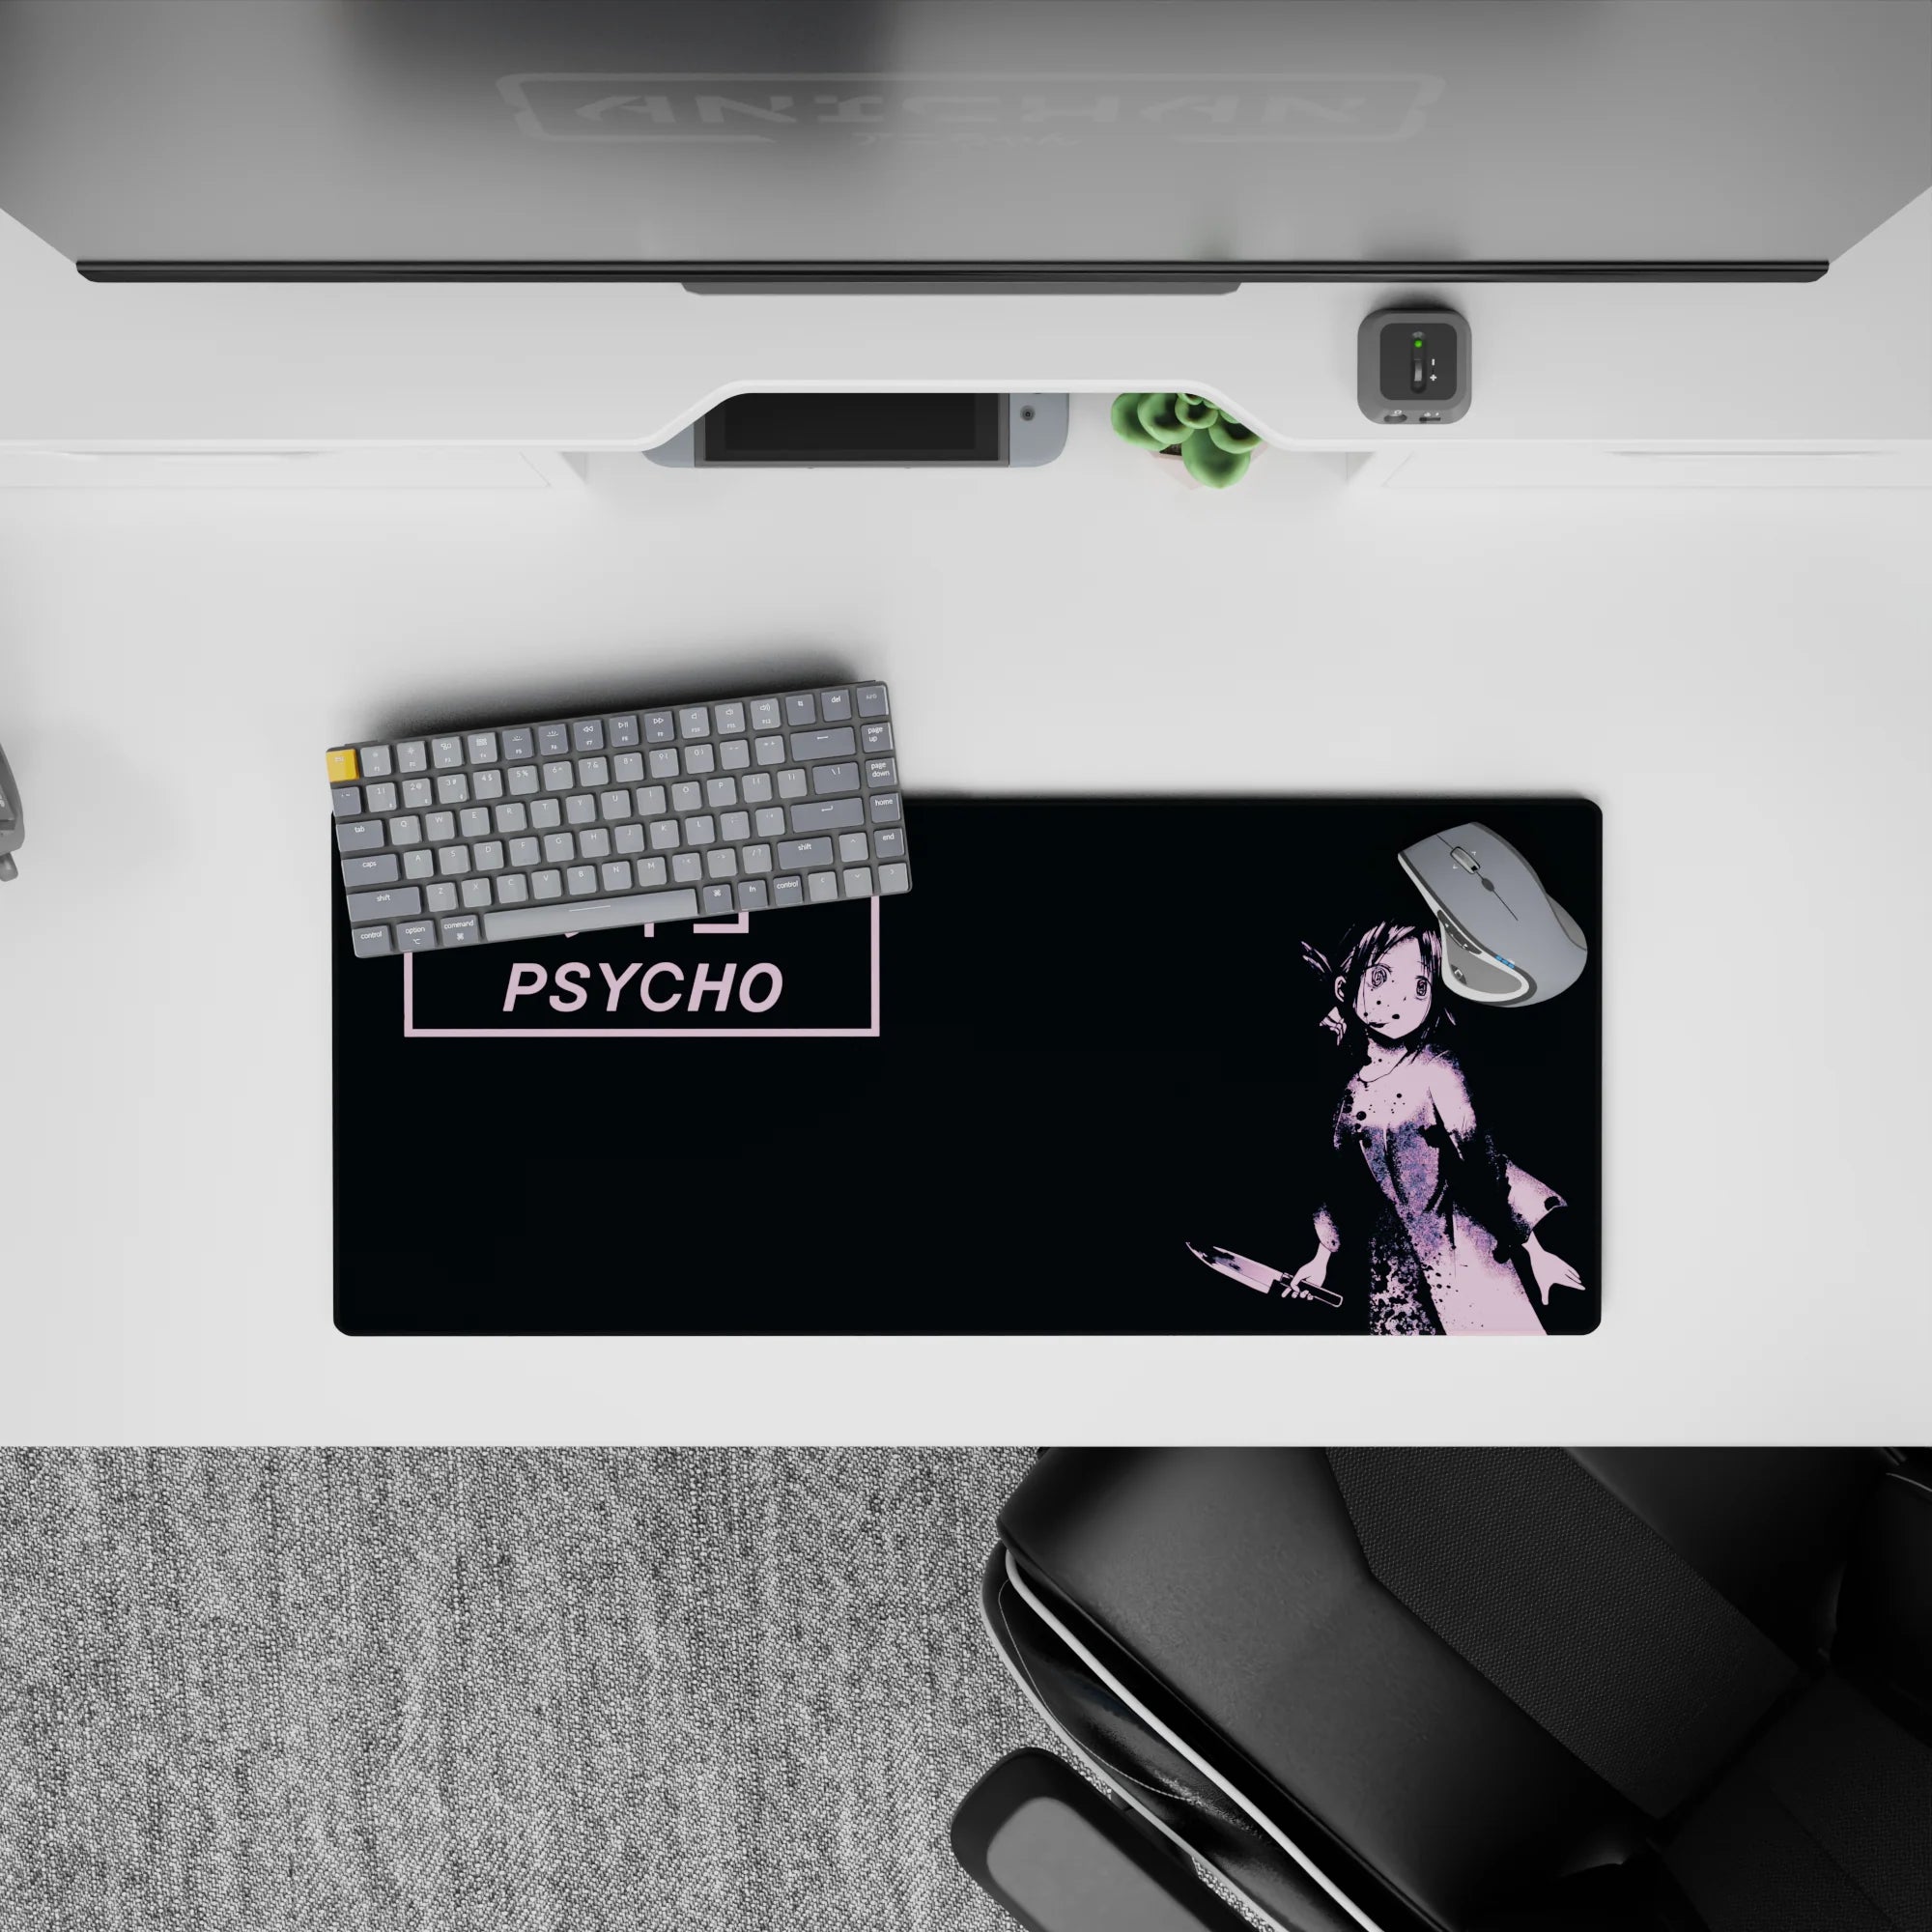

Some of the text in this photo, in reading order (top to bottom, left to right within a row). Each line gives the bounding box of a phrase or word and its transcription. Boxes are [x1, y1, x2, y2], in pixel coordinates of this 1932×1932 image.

[572, 95, 1367, 125] ANICHAN
[867, 725, 883, 734] page
[870, 761, 887, 770] page
[871, 769, 890, 778] down
[874, 798, 894, 807] home
[797, 842, 812, 851] shift
[362, 860, 377, 868] caps
[777, 880, 799, 890] control
[376, 894, 390, 902] shift
[443, 920, 474, 929] command
[405, 925, 426, 935] option
[360, 930, 383, 940] control
[502, 962, 784, 1013] PSYCHO
